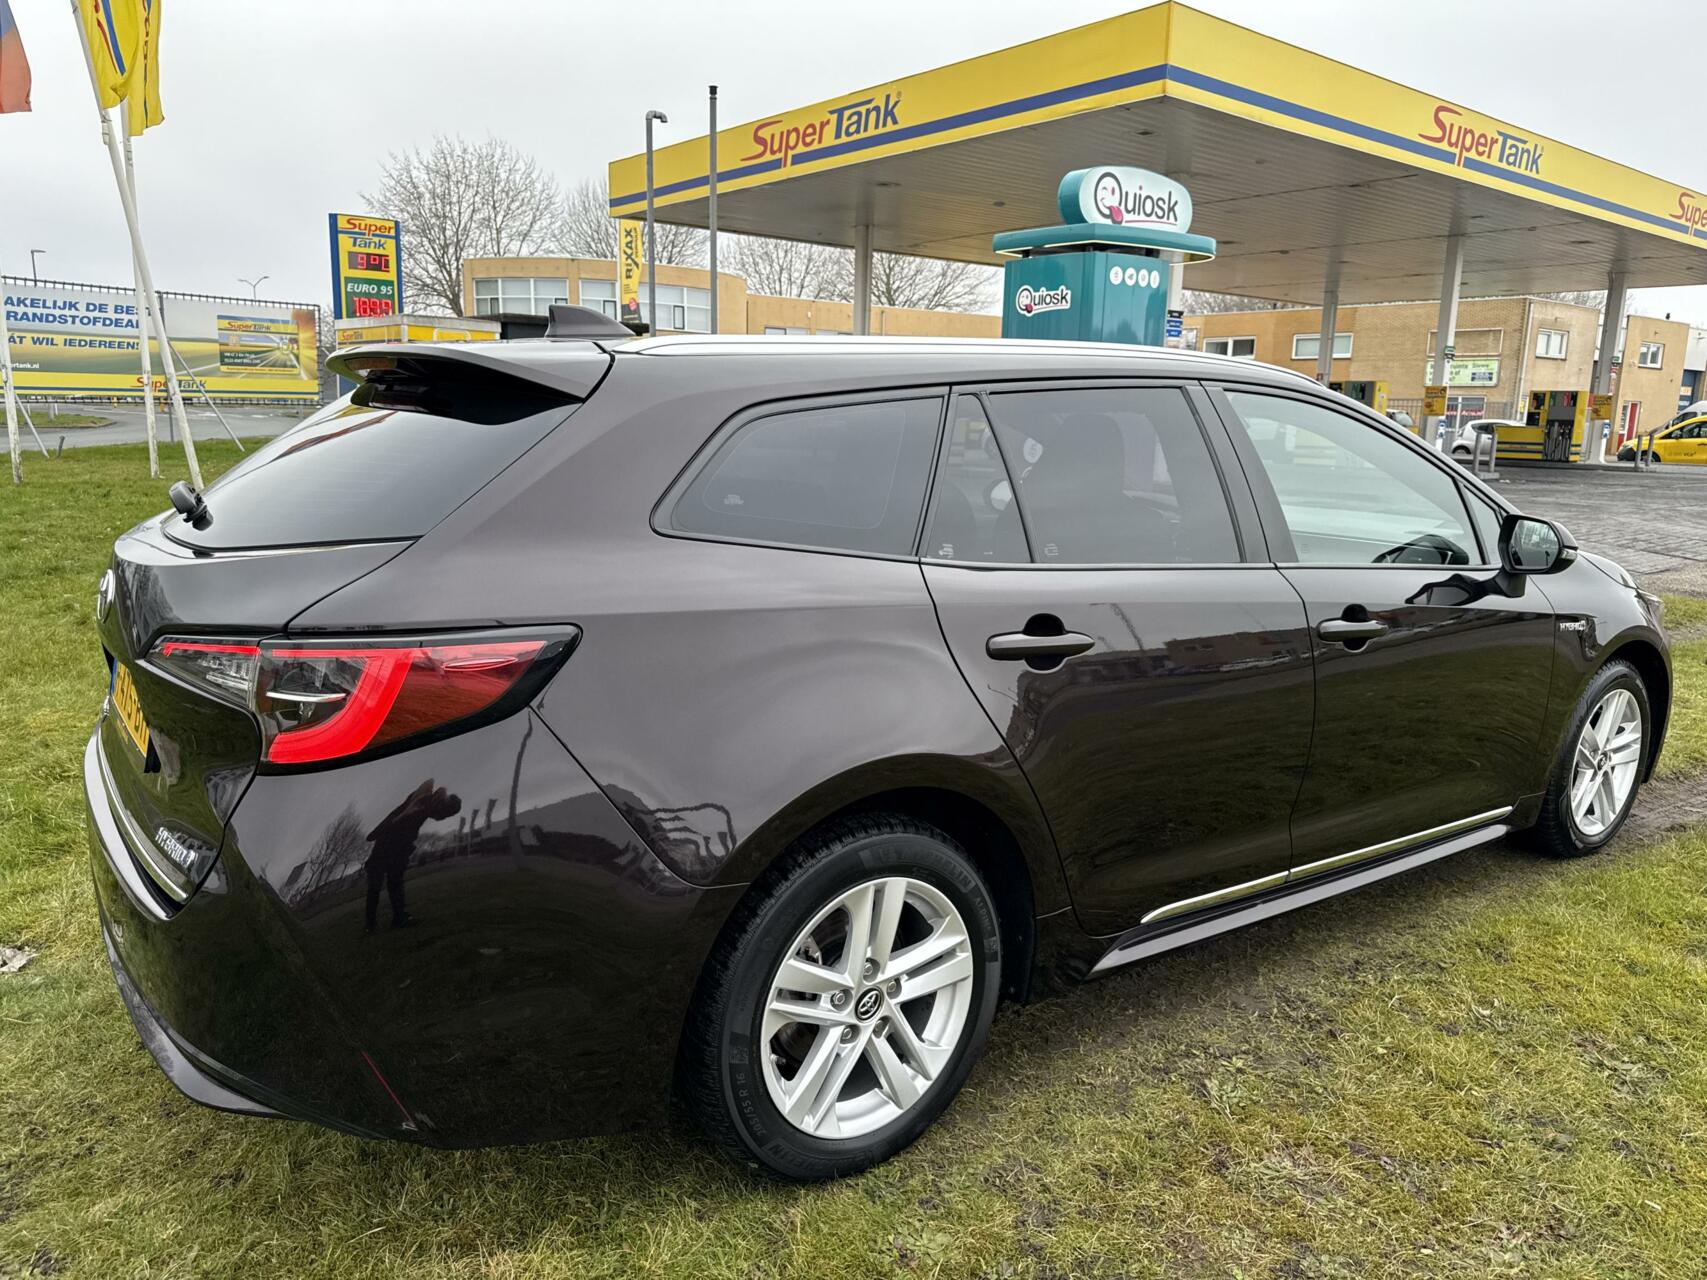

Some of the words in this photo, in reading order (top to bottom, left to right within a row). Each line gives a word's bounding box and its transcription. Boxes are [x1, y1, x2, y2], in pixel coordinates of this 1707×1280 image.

[740, 93, 902, 168] SuperTank
[1418, 105, 1542, 174] SuperTank
[1094, 172, 1178, 224] Quiosk
[1668, 191, 1707, 236] Supe
[339, 217, 394, 236] Super
[348, 236, 388, 250] Tank
[347, 283, 377, 294] EURO
[380, 285, 393, 295] 95
[4, 296, 80, 311] AKELIJK
[85, 302, 109, 313] DE
[1018, 287, 1069, 313] Quiosk
[6, 311, 139, 328] RANDSTOFDEA
[8, 332, 27, 345] ÁT
[32, 336, 58, 346] WIL
[64, 338, 140, 350] IEDEREEN!
[130, 377, 207, 392] SpeTank
